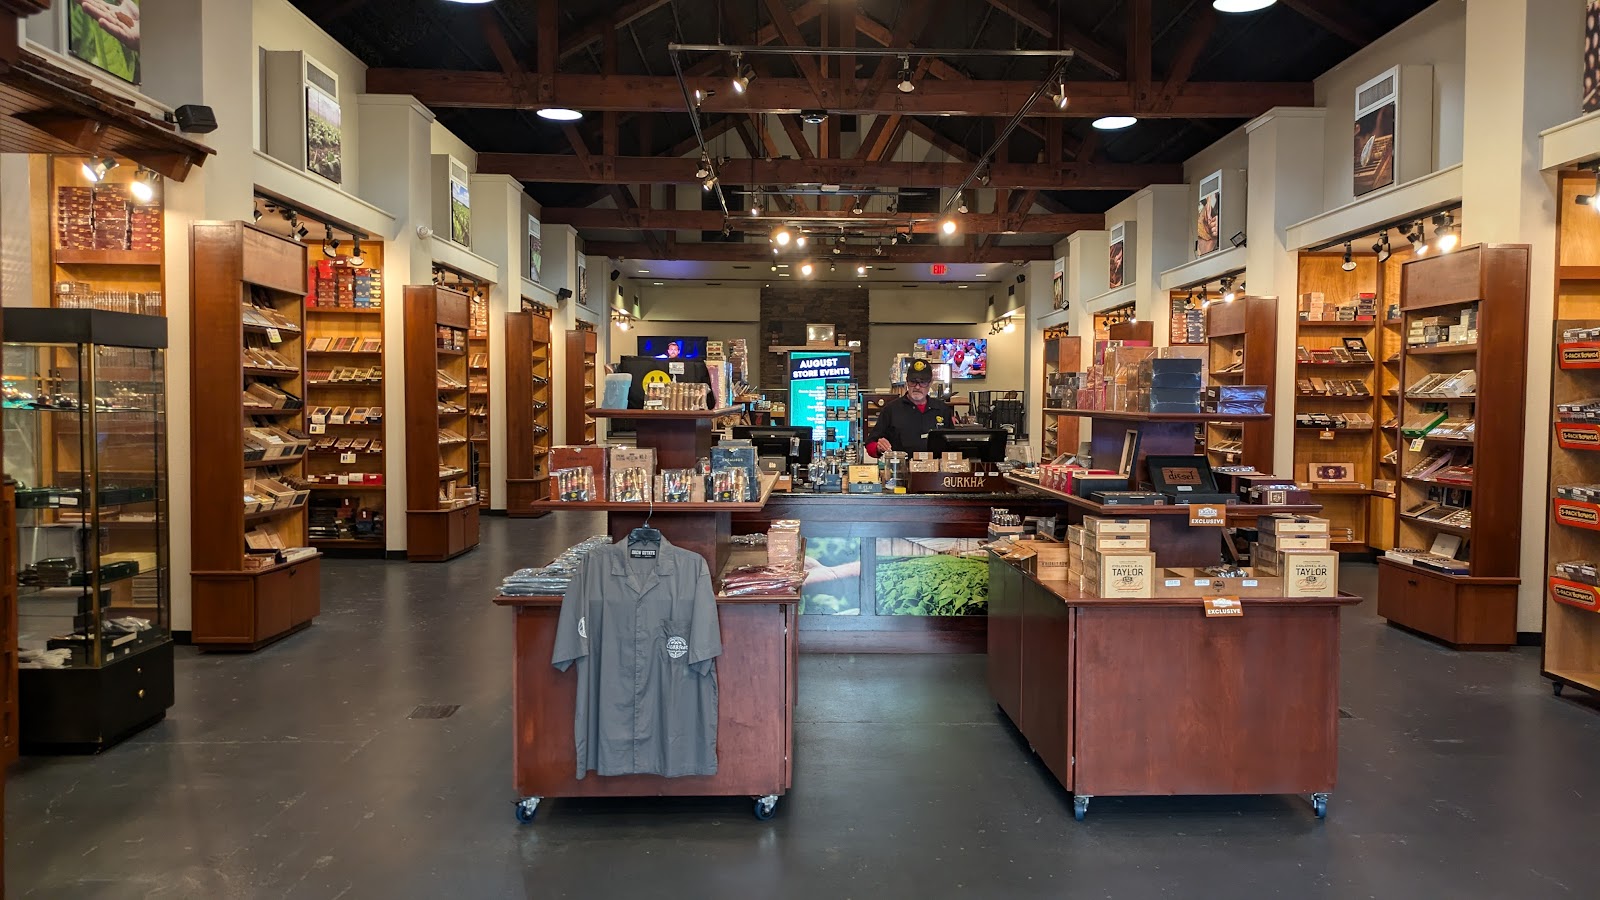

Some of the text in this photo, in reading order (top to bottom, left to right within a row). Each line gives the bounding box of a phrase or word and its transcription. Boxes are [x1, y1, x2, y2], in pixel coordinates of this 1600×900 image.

[799, 358, 838, 368] AUGUST
[793, 367, 850, 378] STORE EVENTS
[1168, 469, 1194, 480] diesel
[1112, 568, 1144, 576] TAYLOR
[1295, 568, 1327, 576] TAYLOR
